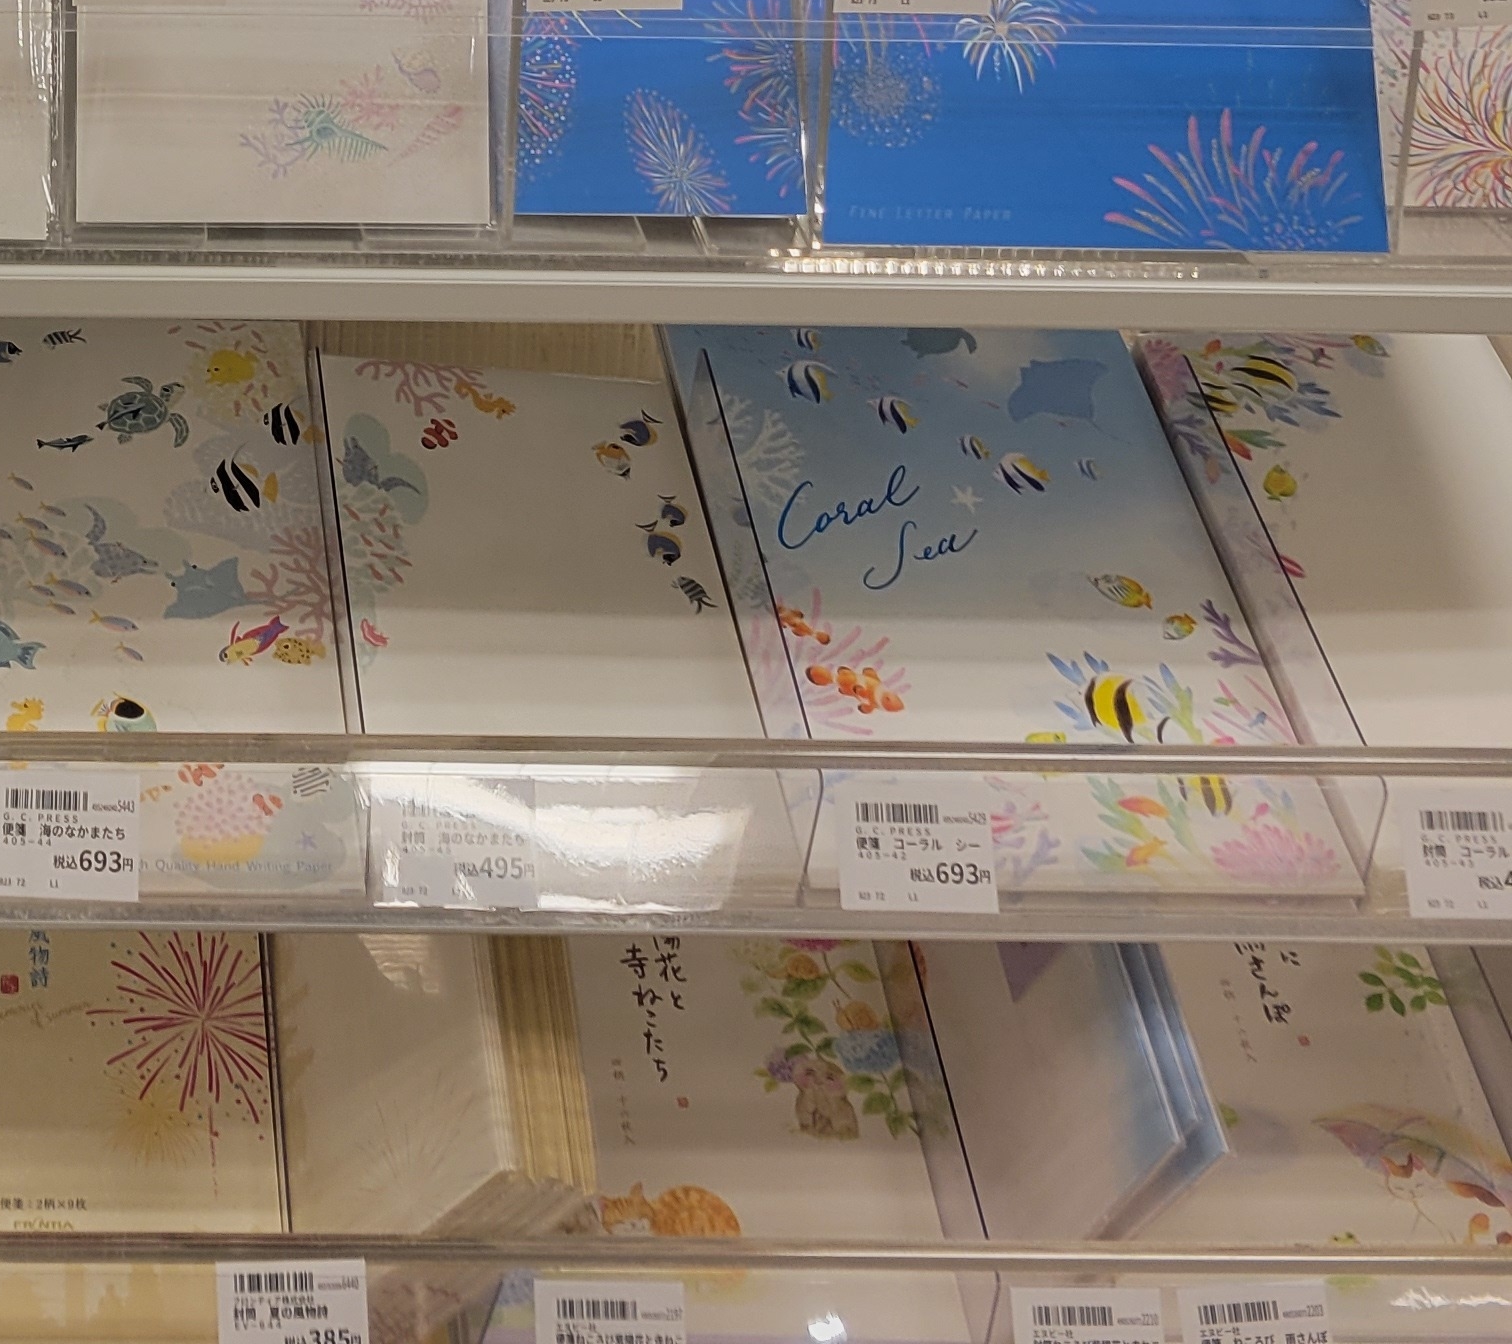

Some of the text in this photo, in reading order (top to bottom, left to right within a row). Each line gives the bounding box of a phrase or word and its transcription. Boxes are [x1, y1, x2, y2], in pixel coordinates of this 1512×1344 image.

[775, 464, 921, 552] Coral
[862, 527, 979, 591] Sea
[39, 824, 126, 841] 海のなかまたち
[53, 850, 134, 873] 税込693円
[909, 862, 990, 885] 税込693円
[620, 942, 669, 1083] 寺ねこたち
